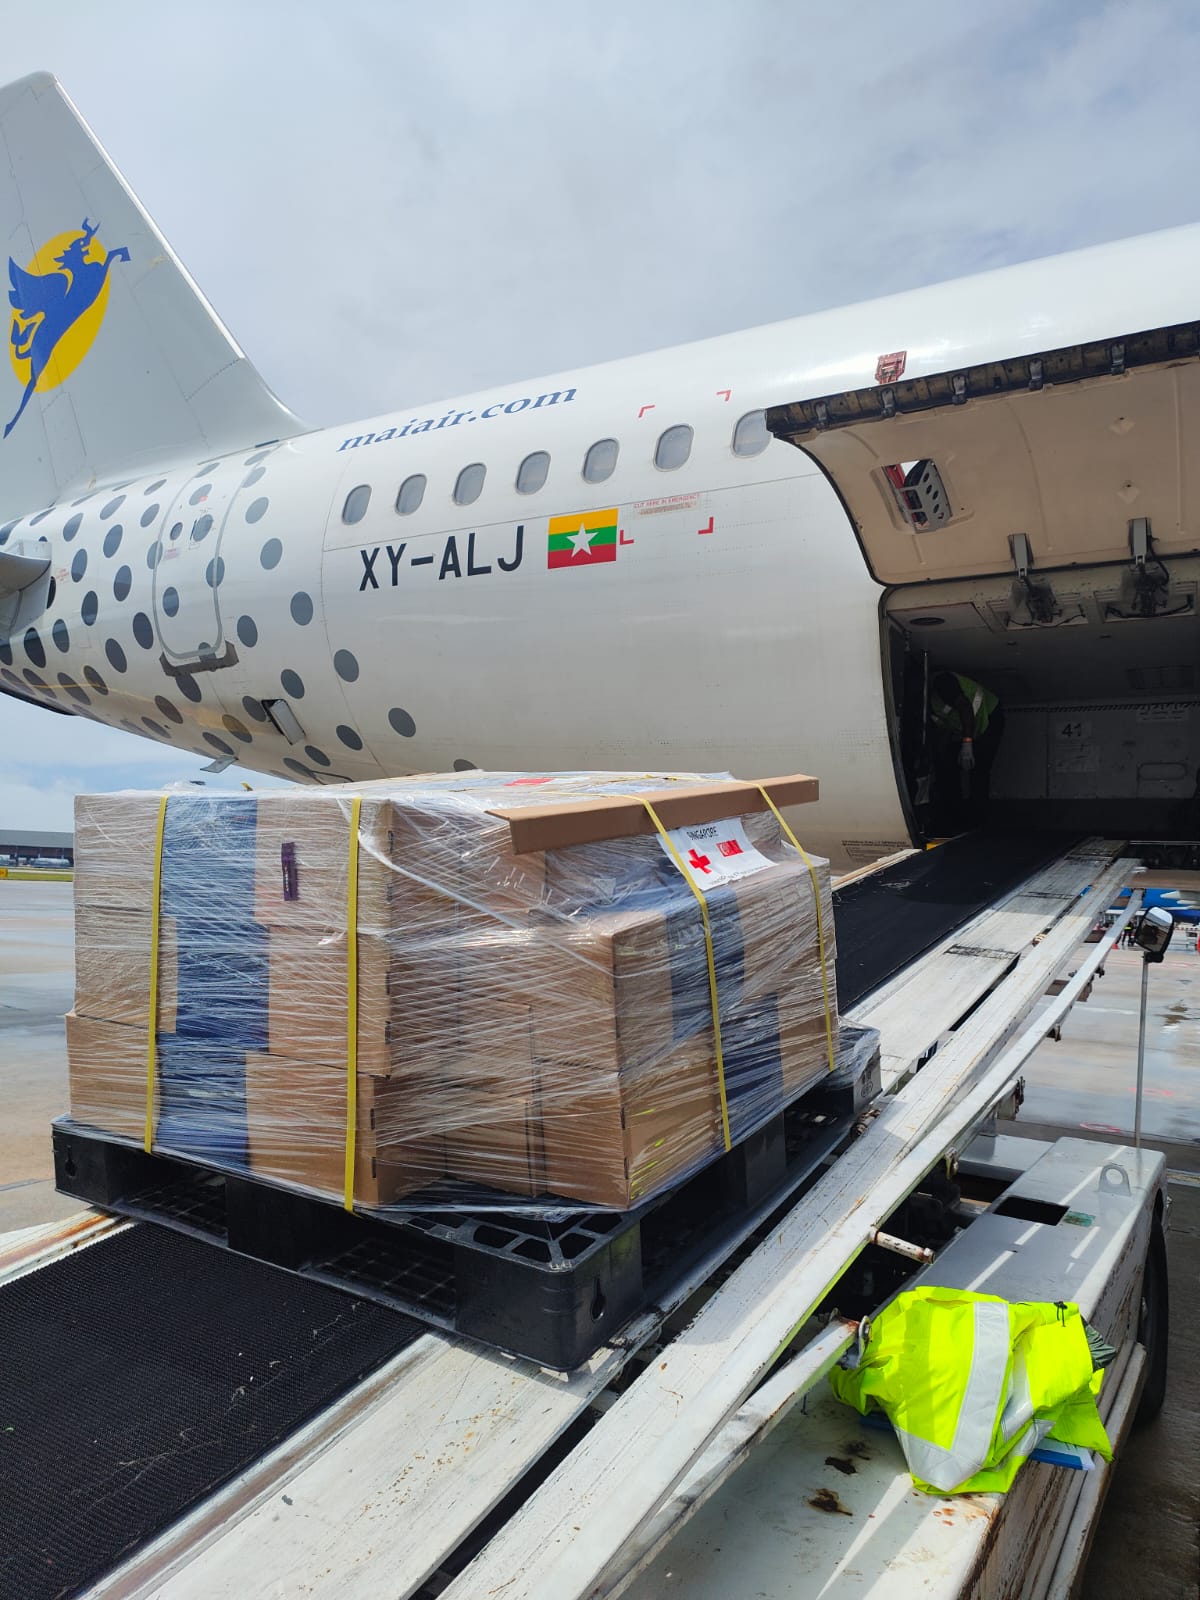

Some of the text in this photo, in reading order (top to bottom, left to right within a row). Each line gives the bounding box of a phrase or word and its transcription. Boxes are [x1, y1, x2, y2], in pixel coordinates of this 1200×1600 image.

[336, 388, 577, 453] maiair.com
[359, 525, 525, 591] XY-ALJ
[1061, 723, 1082, 737] 41
